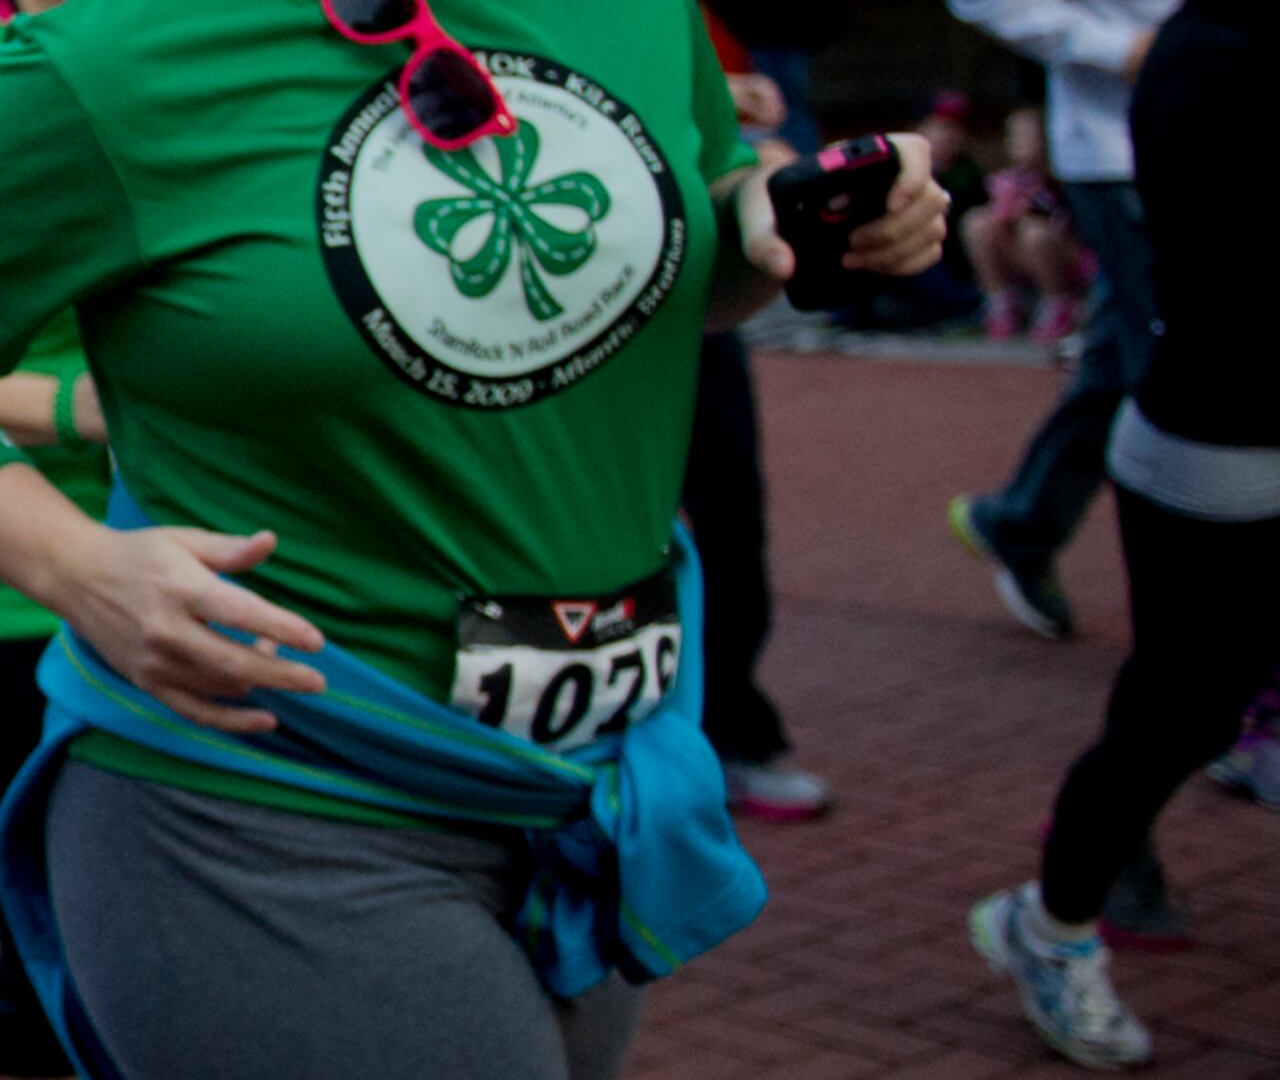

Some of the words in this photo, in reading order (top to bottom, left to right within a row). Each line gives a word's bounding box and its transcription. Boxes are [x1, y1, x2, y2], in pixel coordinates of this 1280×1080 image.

[329, 81, 401, 166] Annual
[321, 171, 351, 248] Fifth
[362, 307, 428, 382] March
[463, 377, 535, 408] 2009
